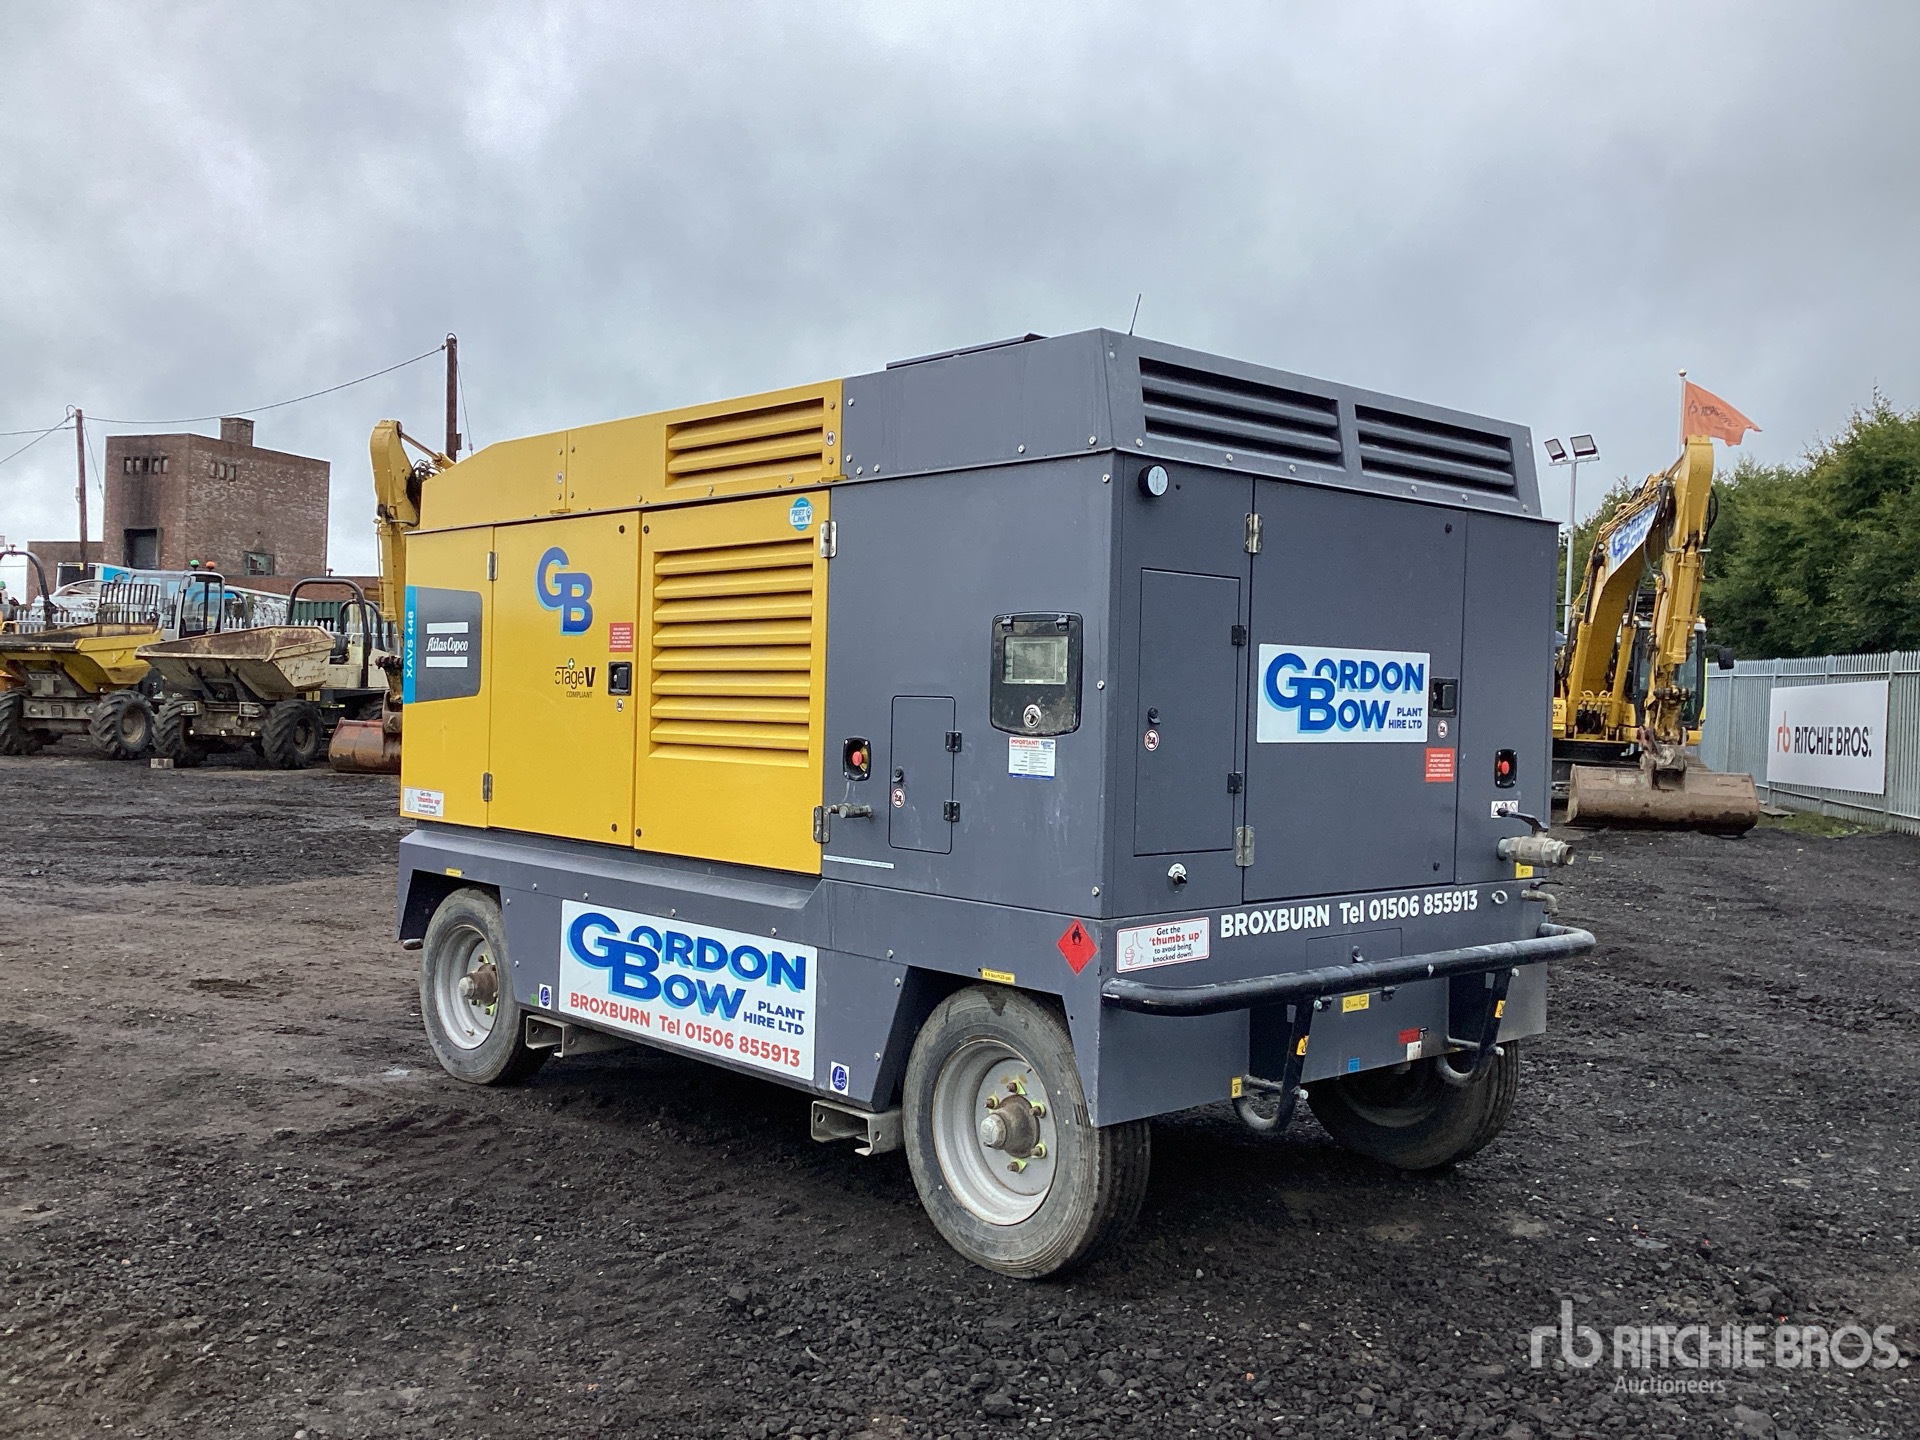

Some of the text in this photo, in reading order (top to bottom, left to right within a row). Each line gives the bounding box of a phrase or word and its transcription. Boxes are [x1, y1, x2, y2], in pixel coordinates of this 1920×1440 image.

[406, 639, 414, 678] XAVS
[1263, 653, 1424, 711] GORDON
[1297, 677, 1390, 734] BOW
[1397, 707, 1423, 718] PLANT
[1388, 719, 1422, 729] HIRE LTD
[1794, 726, 1834, 755] RITCHIE
[1836, 726, 1872, 758] BROS.
[1220, 890, 1478, 938] BROXBURN Tel 01506 855913
[1156, 926, 1181, 936] Get the
[567, 912, 806, 991] GORDON
[1152, 953, 1176, 963] knocked
[1162, 945, 1176, 953] avoid
[1177, 943, 1192, 951] being
[608, 937, 746, 1021] BOW
[743, 1011, 805, 1036] HIRE LTD
[758, 1000, 805, 1021] PLANT
[570, 992, 800, 1068] BROXBURN Tel 01506 855913
